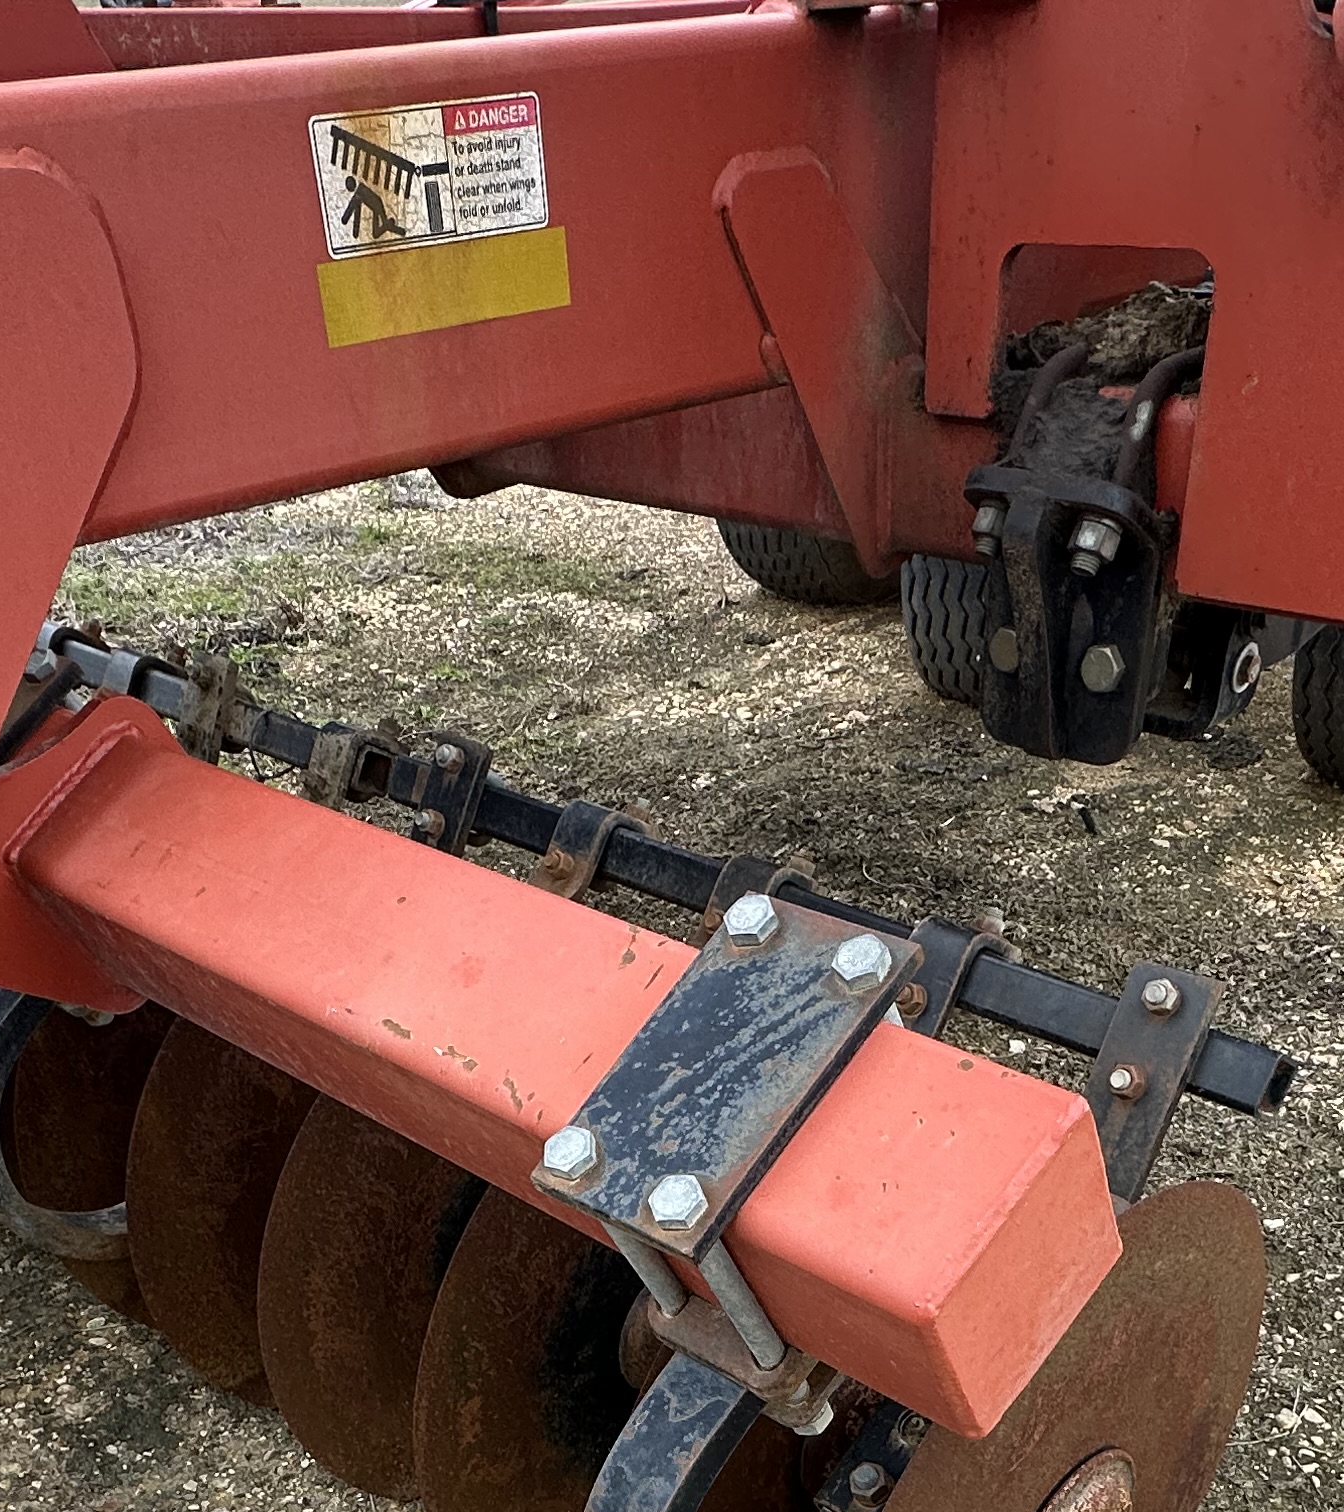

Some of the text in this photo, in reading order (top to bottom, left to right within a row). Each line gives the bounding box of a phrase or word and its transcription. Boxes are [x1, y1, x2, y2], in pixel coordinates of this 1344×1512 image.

[469, 104, 528, 128] DANGER
[451, 136, 521, 155] To avoid injury
[455, 157, 521, 177] or death stand
[457, 178, 536, 199] clear when wings
[459, 205, 477, 219] fold
[480, 205, 489, 217] or
